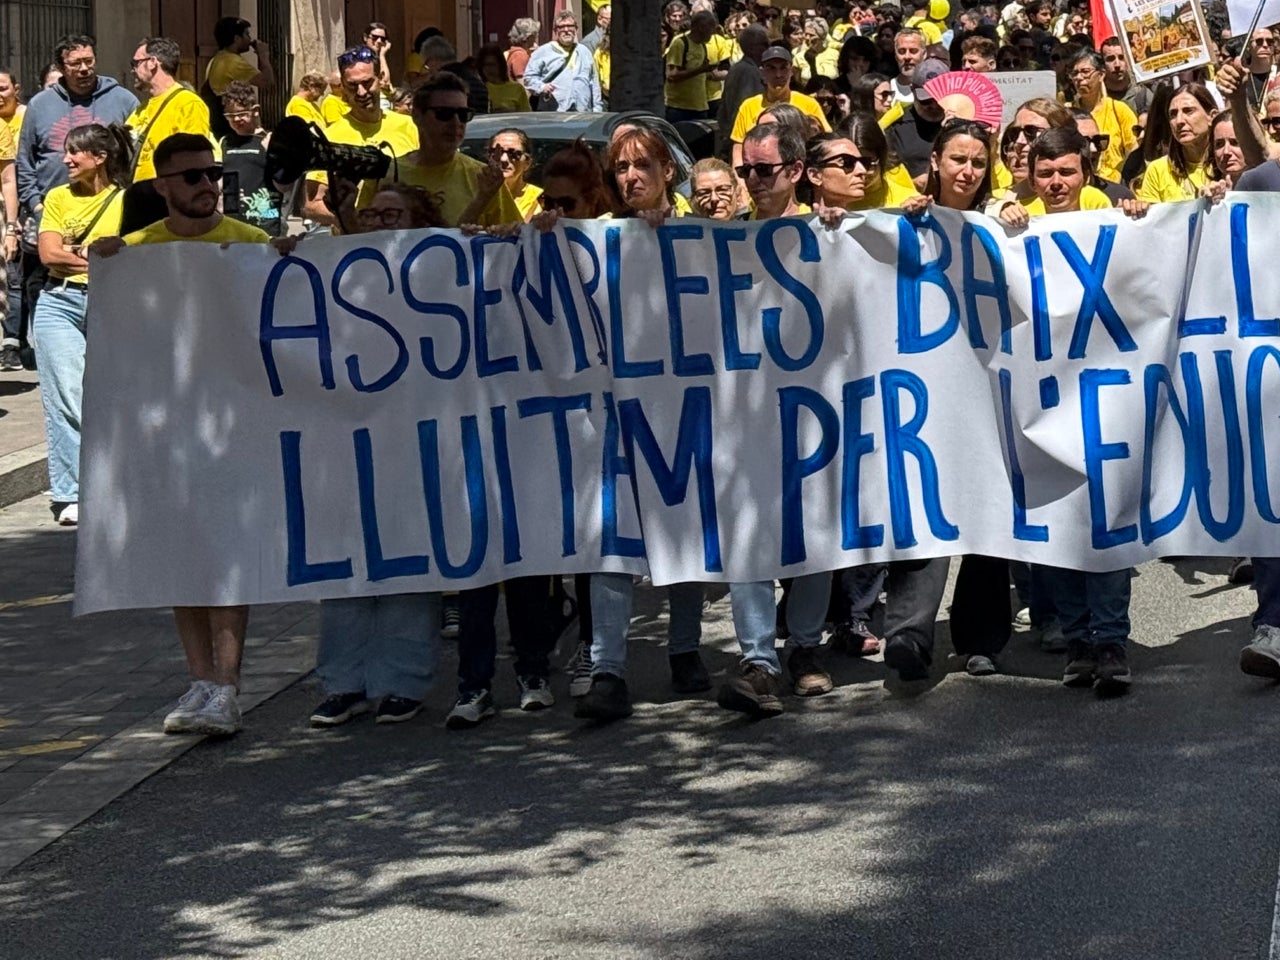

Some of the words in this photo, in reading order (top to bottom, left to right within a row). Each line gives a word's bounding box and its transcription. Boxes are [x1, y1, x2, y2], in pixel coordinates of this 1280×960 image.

[946, 76, 961, 90] NO
[962, 79, 988, 96] PUC
[897, 212, 1138, 362] BAIX
[280, 386, 724, 586] LLUITEM
[777, 369, 960, 566] PER
